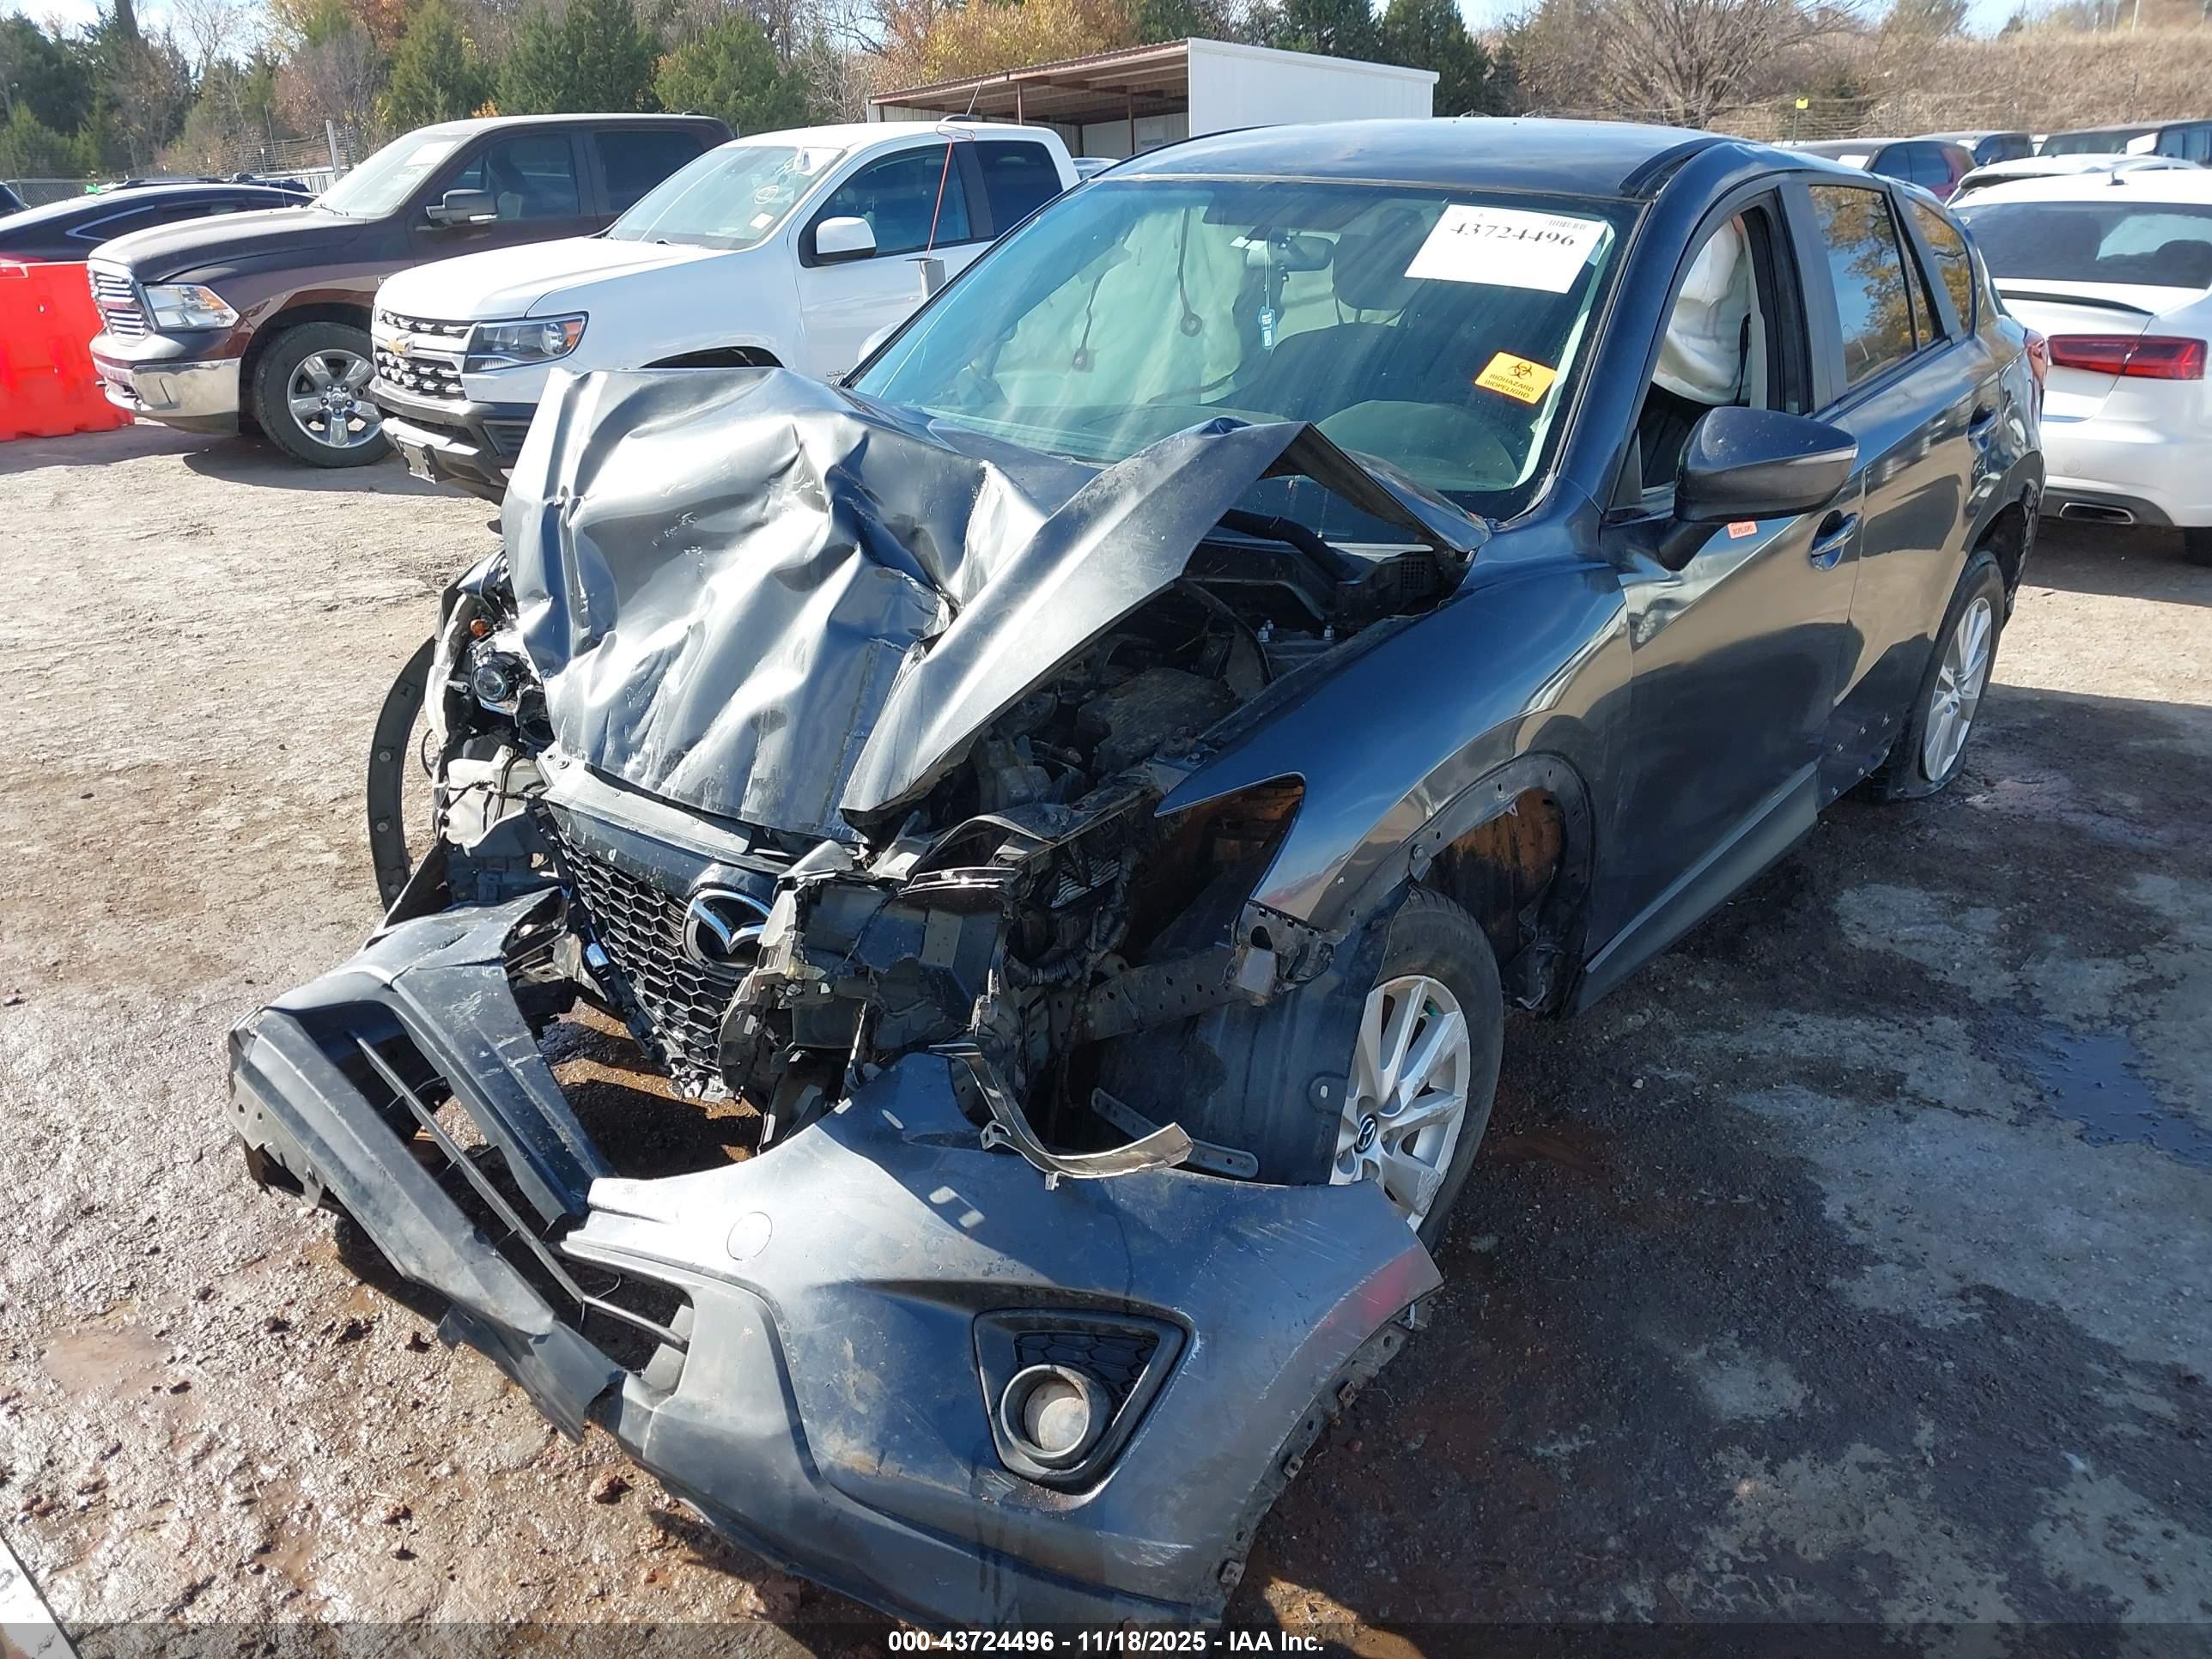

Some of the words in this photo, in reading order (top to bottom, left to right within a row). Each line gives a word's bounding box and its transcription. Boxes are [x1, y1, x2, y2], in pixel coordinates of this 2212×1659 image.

[1449, 222, 1575, 246] 43724496
[1484, 379, 1530, 398] BIOPELIGRO
[1489, 374, 1534, 392] BIOHAZARD
